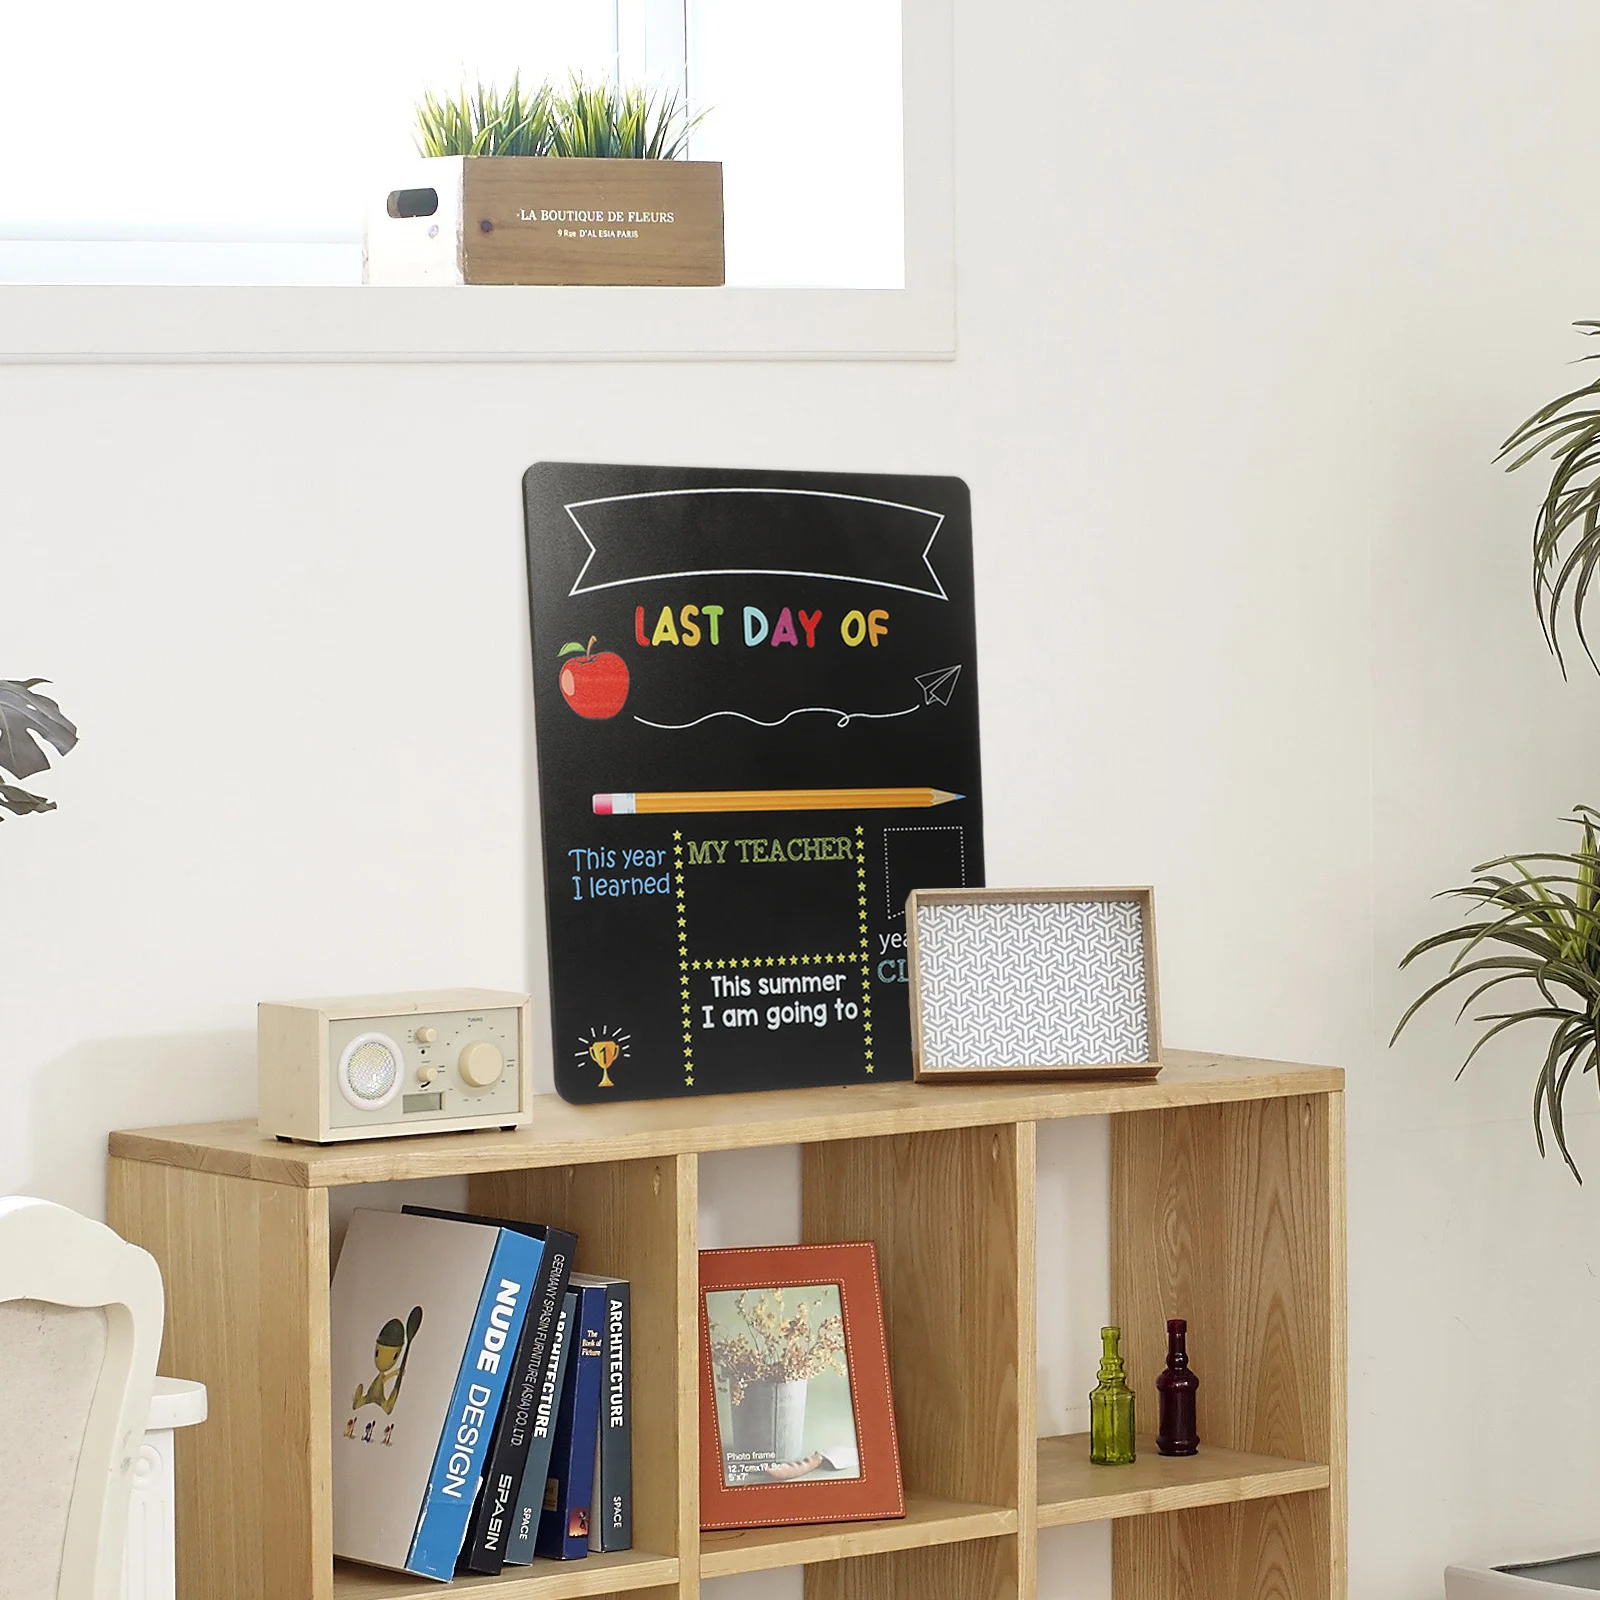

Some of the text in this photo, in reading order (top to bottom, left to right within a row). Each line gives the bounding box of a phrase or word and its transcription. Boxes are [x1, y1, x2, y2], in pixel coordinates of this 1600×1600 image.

[520, 209, 674, 223] LA BOUTIQUE DE FLEURS
[557, 229, 563, 237] 9
[564, 230, 576, 238] Rue
[617, 230, 639, 238] PARIS
[635, 604, 889, 648] LAST DAY OF
[568, 846, 666, 872] This year
[687, 837, 853, 865] MY TEACHER
[572, 872, 670, 900] I learned
[711, 974, 847, 998] This summer
[701, 998, 859, 1030] I am going to
[546, 1254, 565, 1299] GERMANY
[537, 1299, 554, 1332] SPASIN
[587, 1329, 599, 1338] The
[525, 1331, 547, 1384] FURNITURE
[609, 1300, 624, 1428] ARCHITECTURE
[442, 1278, 521, 1498] NUDE DESIGN
[726, 1451, 776, 1461] Photo frame
[485, 1473, 513, 1551] SPASIN
[519, 1507, 532, 1540] SPACE
[612, 1496, 623, 1528] SPACE
